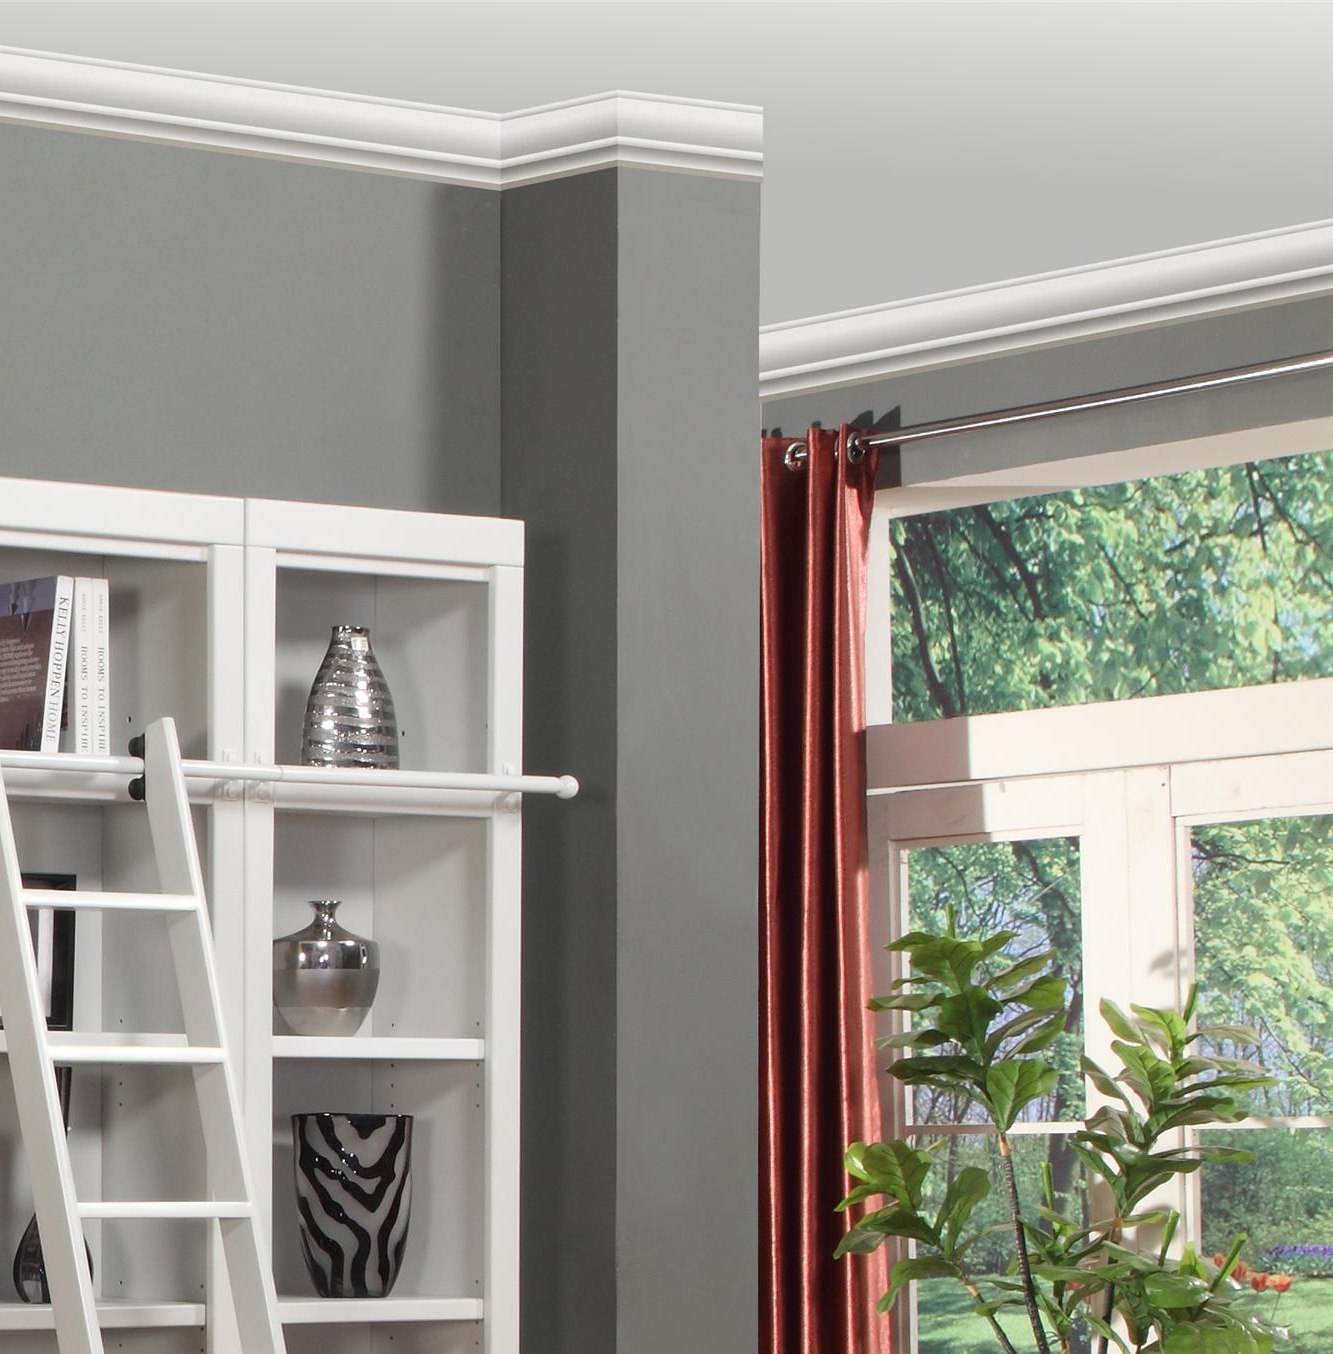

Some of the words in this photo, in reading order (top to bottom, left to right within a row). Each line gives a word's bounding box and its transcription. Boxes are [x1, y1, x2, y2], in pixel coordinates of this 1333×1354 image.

[55, 597, 69, 640] KELLY
[50, 640, 65, 697] HOPPEN
[81, 688, 88, 700] TO
[98, 688, 105, 701] TO
[46, 701, 59, 742] HOME
